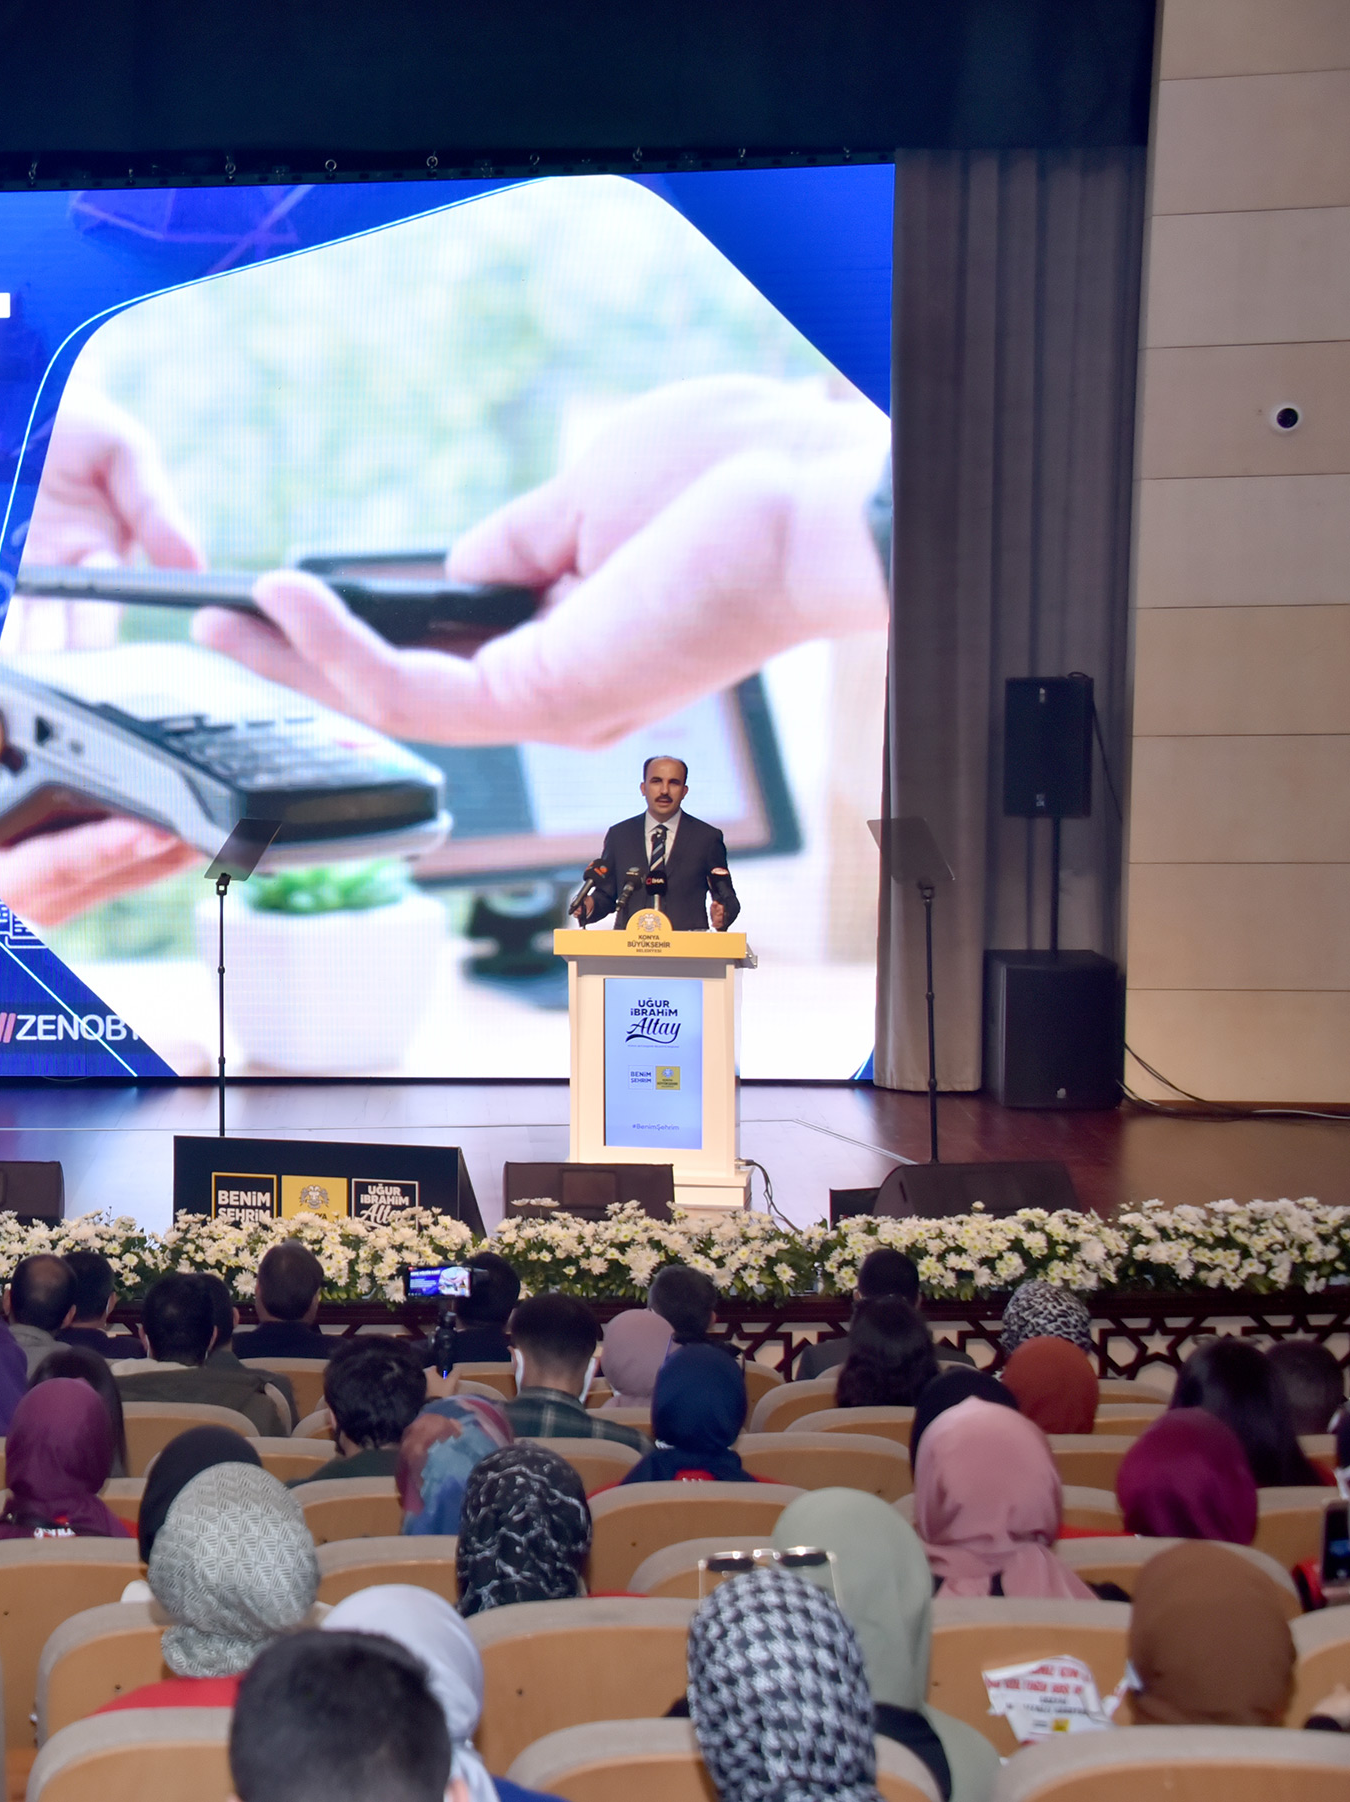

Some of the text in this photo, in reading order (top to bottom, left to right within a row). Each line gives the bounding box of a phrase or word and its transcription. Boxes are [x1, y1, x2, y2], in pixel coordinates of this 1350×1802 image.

[638, 997, 670, 1008] UĞUR
[625, 1017, 681, 1044] Altay
[368, 1183, 402, 1195] UĞUR
